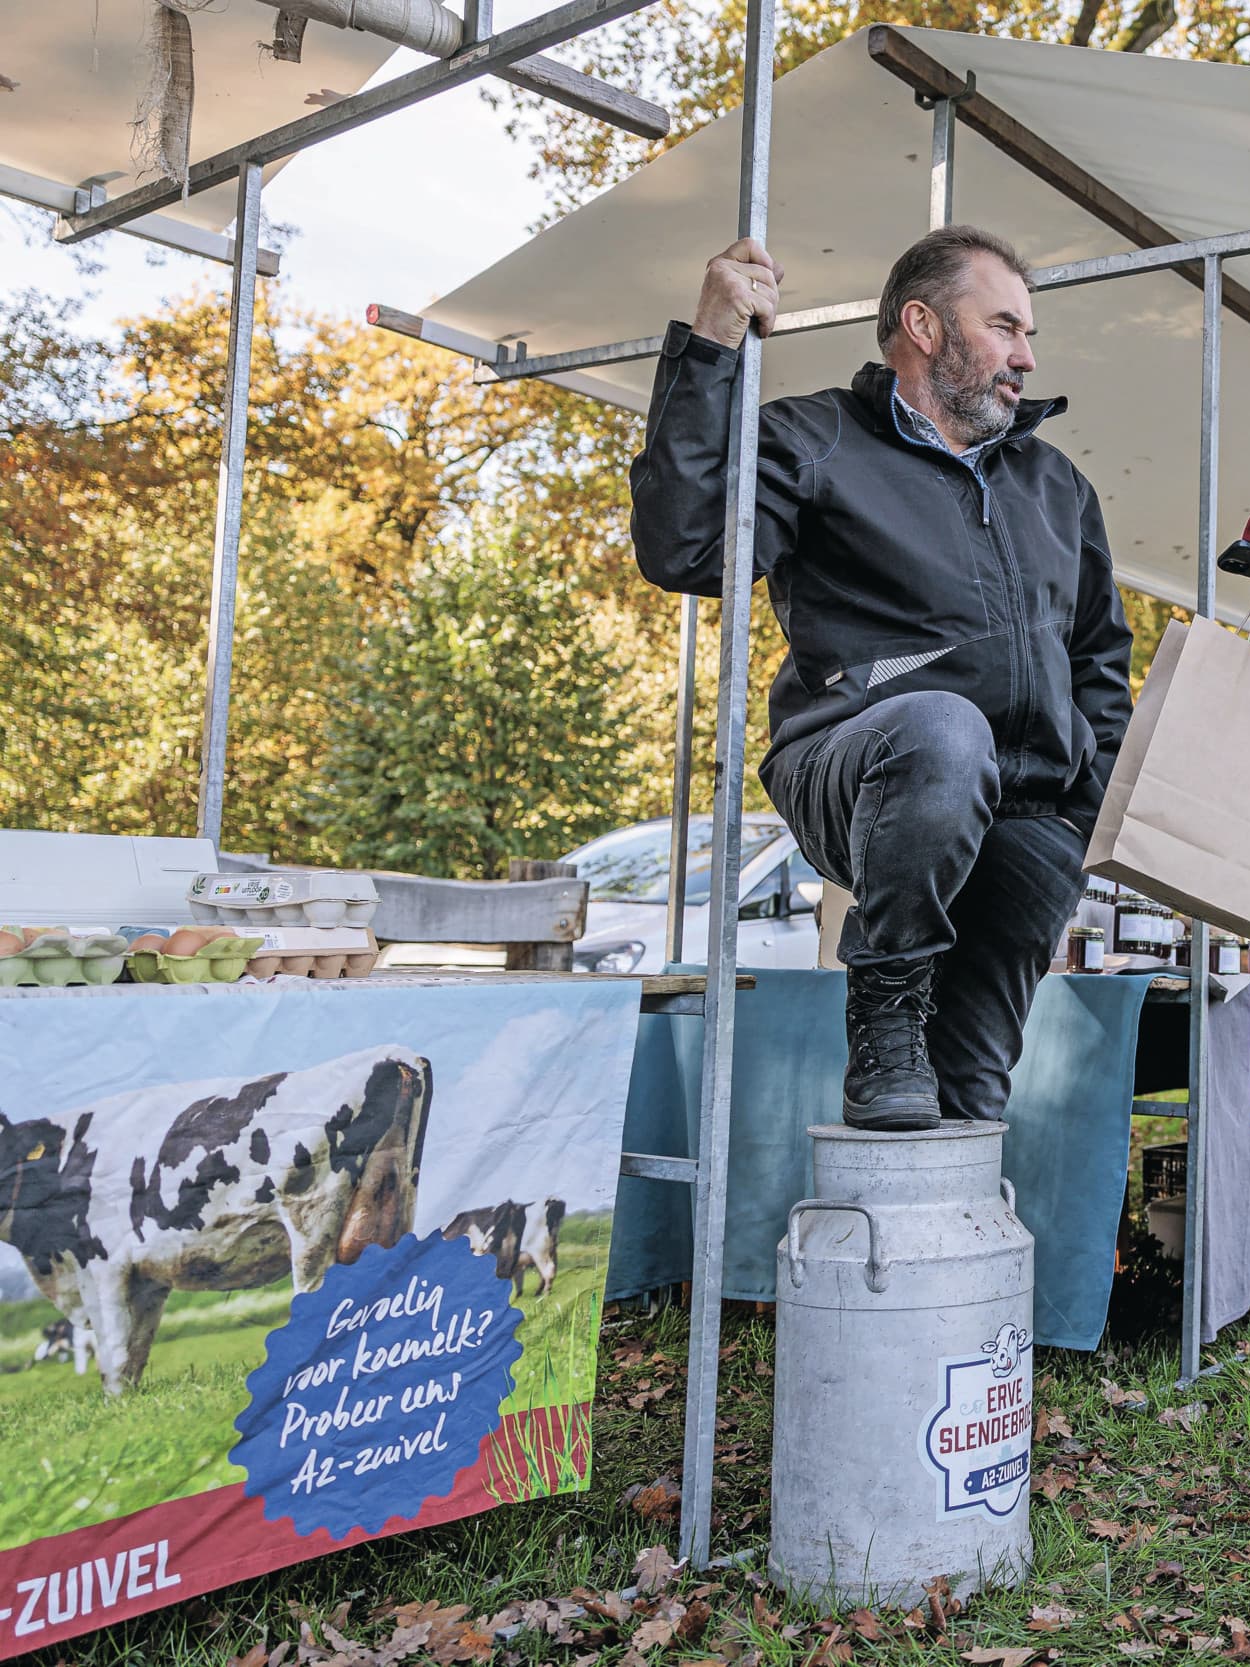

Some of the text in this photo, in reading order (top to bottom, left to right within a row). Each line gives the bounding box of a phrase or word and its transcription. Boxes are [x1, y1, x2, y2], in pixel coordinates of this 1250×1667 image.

[326, 1276, 444, 1339] Gevoelig
[283, 1308, 493, 1398] voor koemelk?
[280, 1372, 462, 1448] Probeer eens
[987, 1377, 1023, 1414] ERVE
[291, 1412, 447, 1494] A2-zuivel
[981, 1457, 1024, 1489] A2-ZUIVEL
